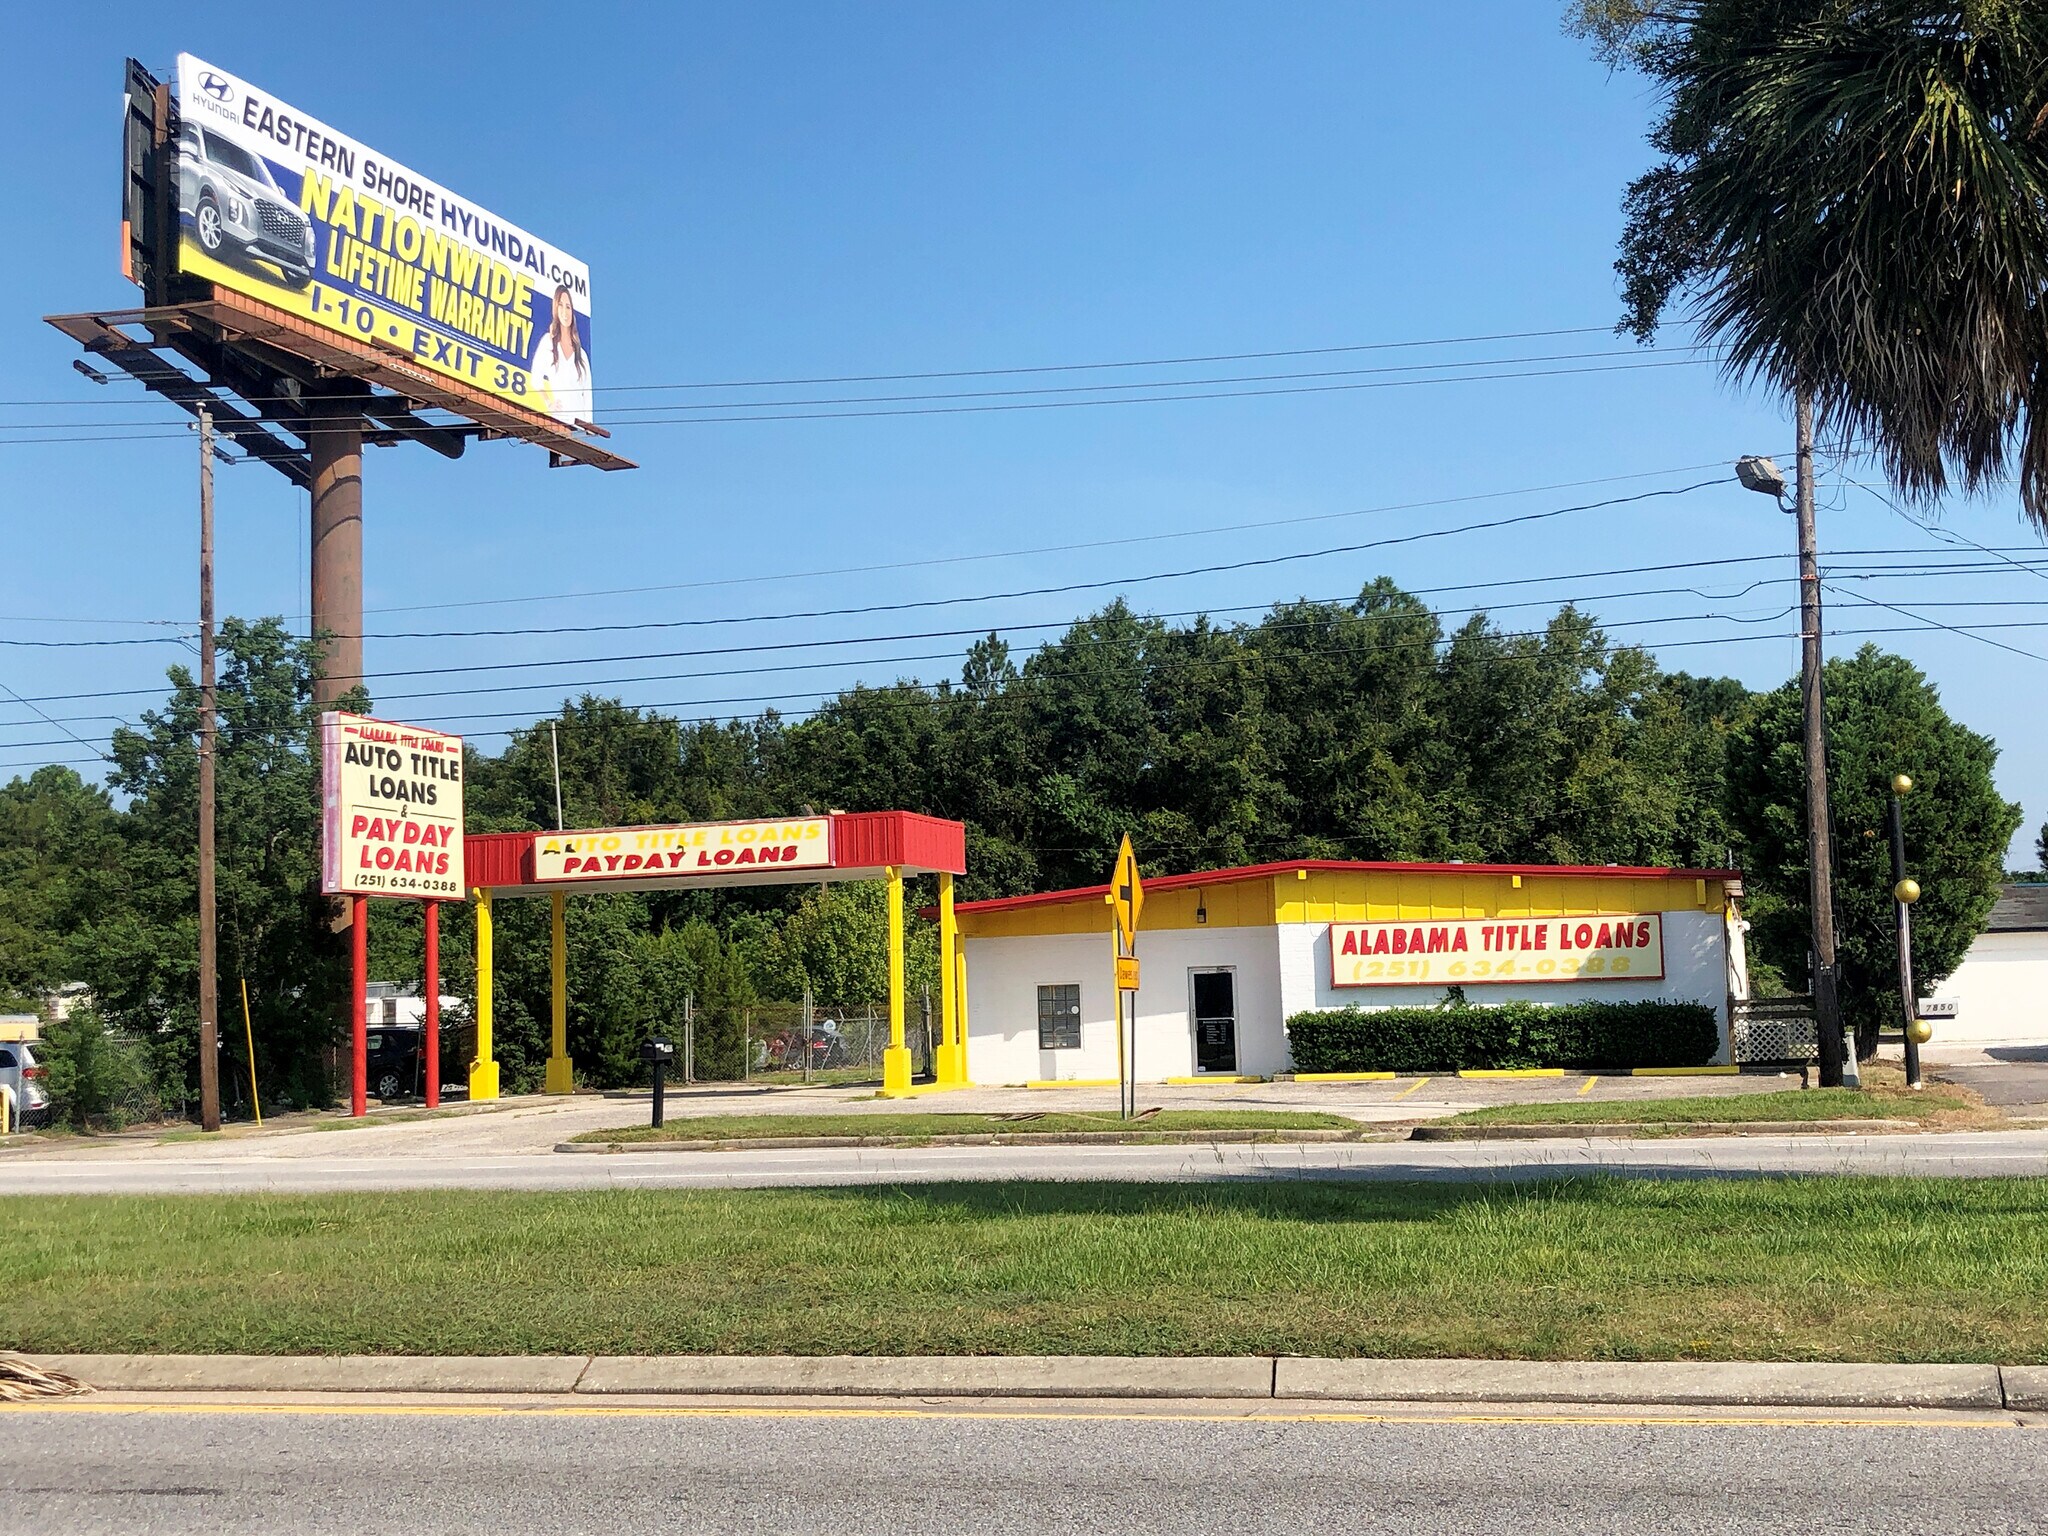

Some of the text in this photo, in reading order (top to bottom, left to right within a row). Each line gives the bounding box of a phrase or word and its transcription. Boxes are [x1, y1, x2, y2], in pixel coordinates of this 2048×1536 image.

[193, 93, 239, 124] HYUNDAI
[243, 96, 587, 297] EASTERN SHORE HYUNDAI.COM
[299, 166, 535, 318] NATIONWIDE
[326, 229, 426, 313] LIFETIME
[430, 275, 534, 360] WARRANTY
[311, 286, 374, 333] I-10
[413, 328, 483, 378] EXIT
[494, 364, 527, 396] 38
[421, 737, 445, 753] LOANS
[345, 742, 459, 782] AUTO TITLE
[370, 774, 437, 805] LOANS
[401, 805, 408, 818] &
[351, 815, 455, 848] PAYDAY
[542, 823, 820, 855] AUTO TITLE LOANS
[360, 845, 450, 875] LOANS
[563, 845, 798, 874] PAYDAY LOANS
[354, 874, 457, 892] (251) 634-0388
[1341, 921, 1650, 955] ALABAMA TITLE LOANS
[1353, 956, 1631, 981] (251) 634-0388
[1926, 1004, 1953, 1012] 7850
